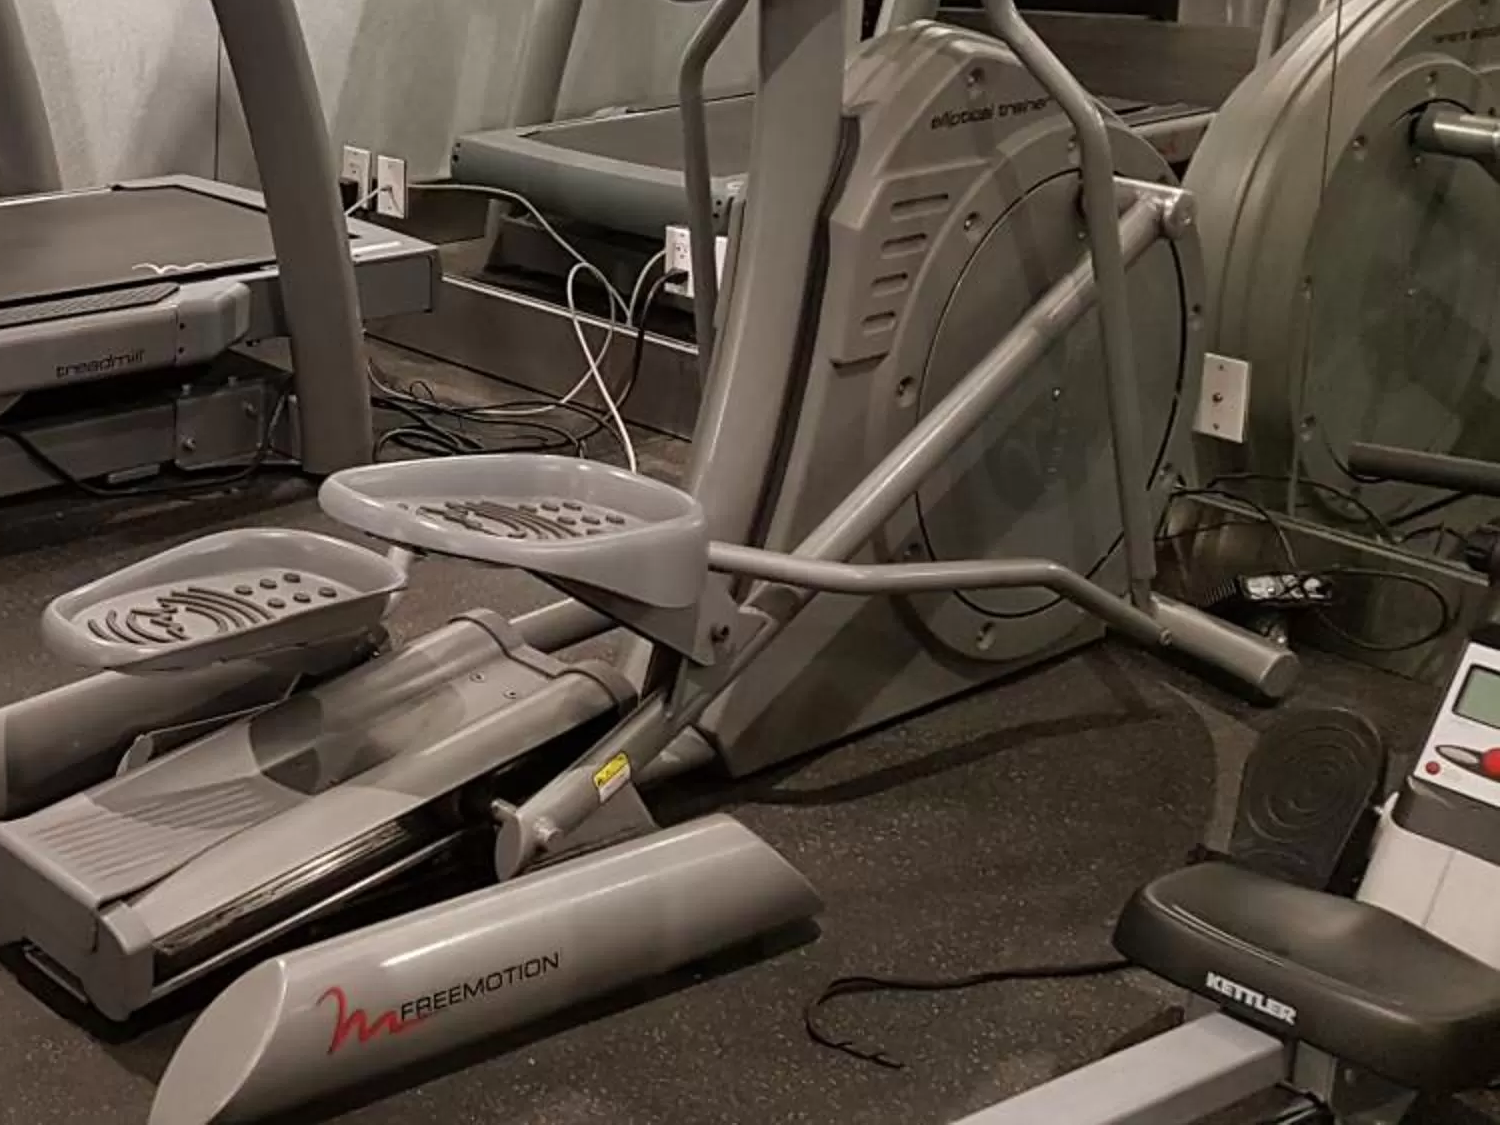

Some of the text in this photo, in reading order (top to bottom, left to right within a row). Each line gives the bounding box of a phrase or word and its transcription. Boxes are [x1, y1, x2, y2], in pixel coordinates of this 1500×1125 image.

[55, 347, 146, 379] treadmill
[400, 951, 560, 1023] FREEMOTION
[1205, 970, 1298, 1026] KETTLER
